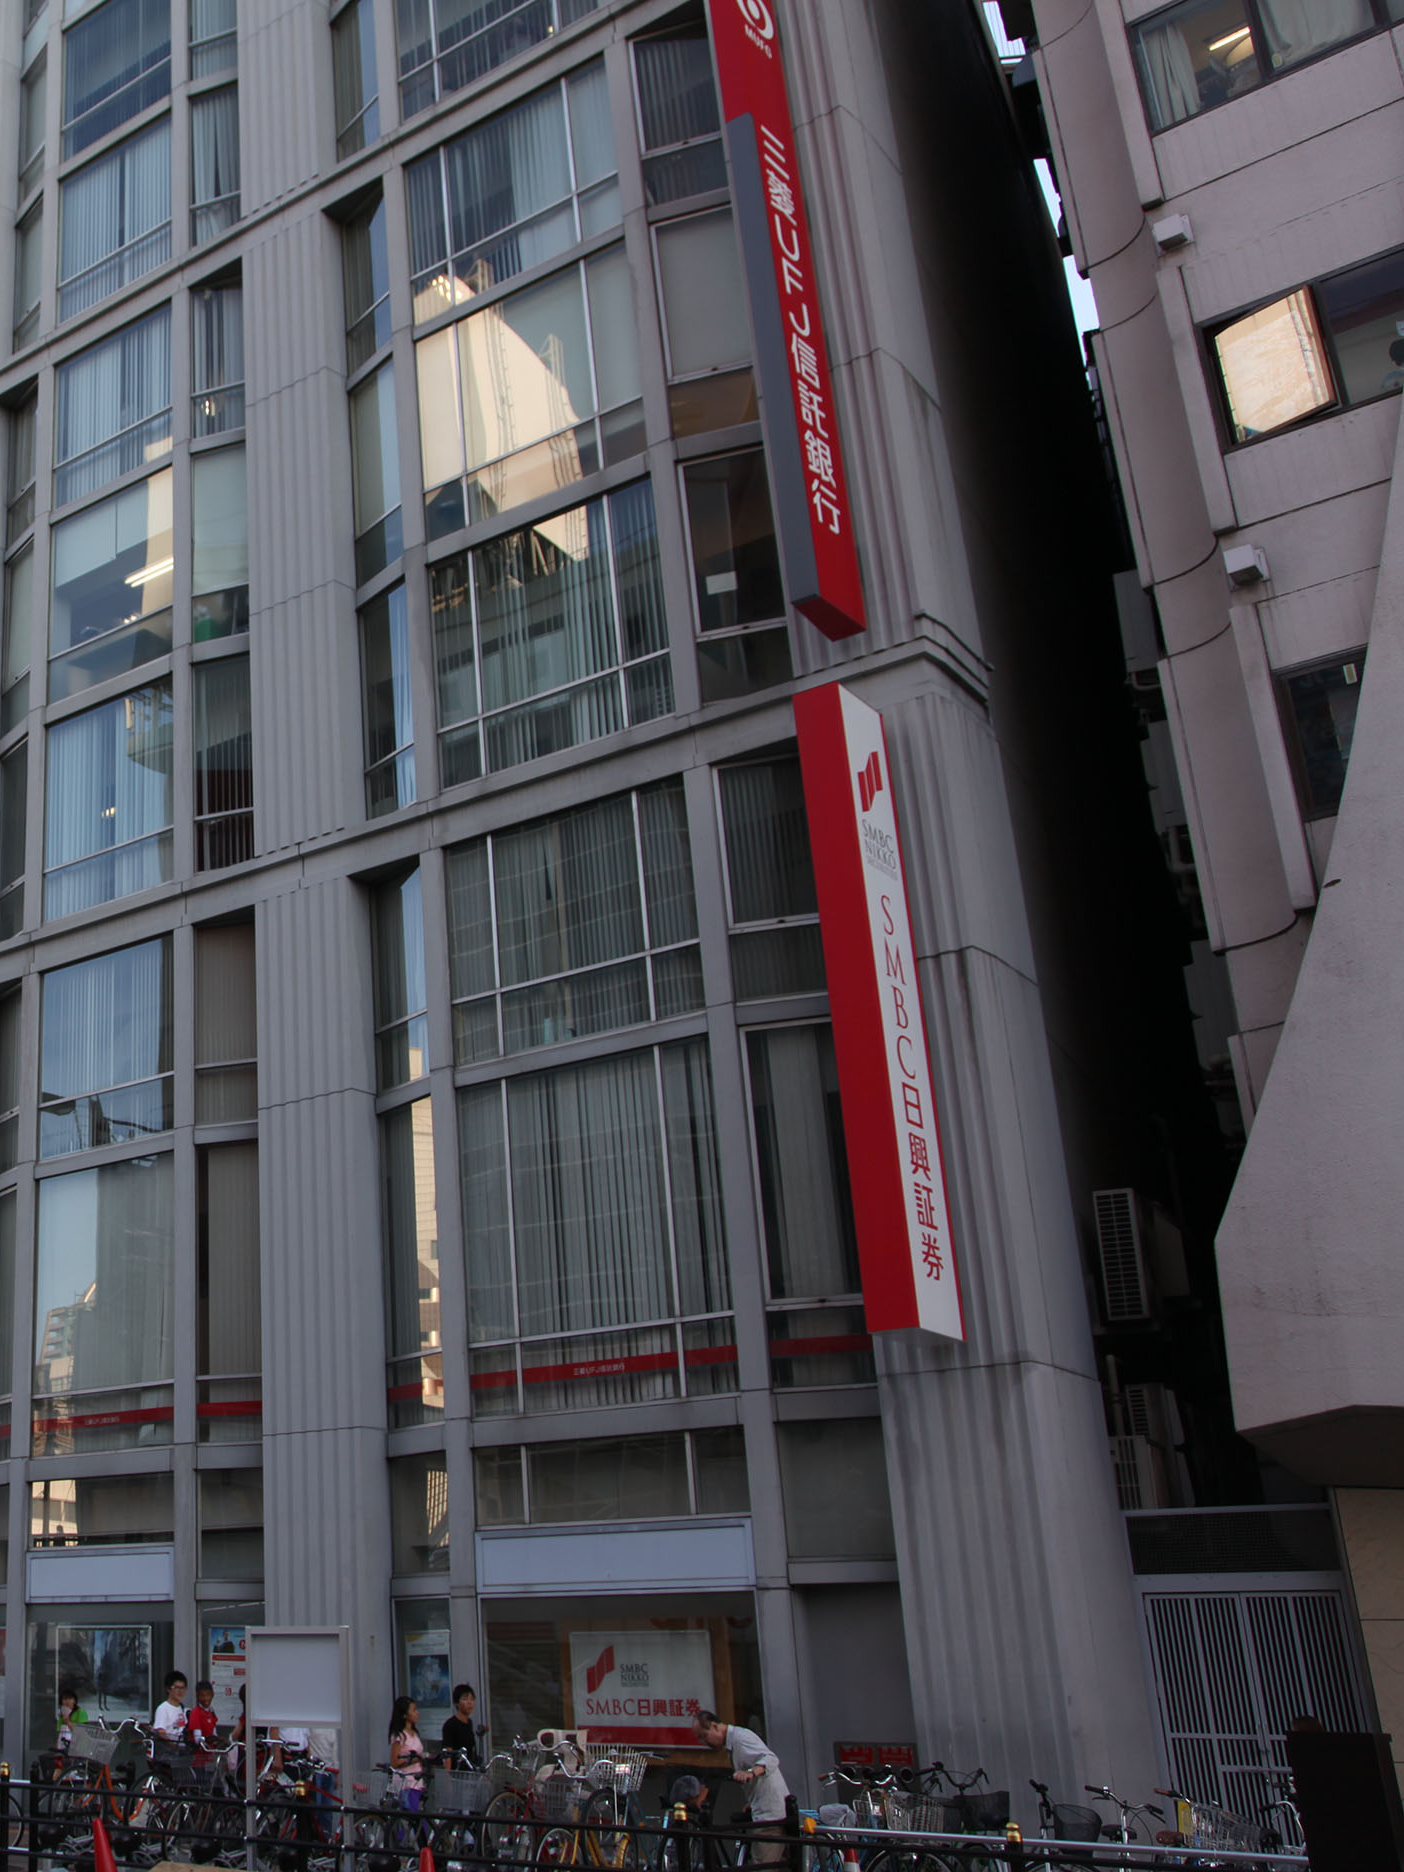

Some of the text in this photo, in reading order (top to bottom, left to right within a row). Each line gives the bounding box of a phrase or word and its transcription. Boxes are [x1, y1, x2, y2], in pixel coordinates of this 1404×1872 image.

[743, 24, 773, 59] MUFG
[760, 124, 842, 535] 三菱UFJ信託銀行
[861, 818, 894, 854] SMBC
[864, 838, 897, 870] NIKKO
[880, 894, 945, 1281] SMBC日興証券
[619, 1663, 649, 1674] SMBC
[620, 1674, 649, 1682] NIKKO
[585, 1698, 701, 1717] SMBC日興証券
